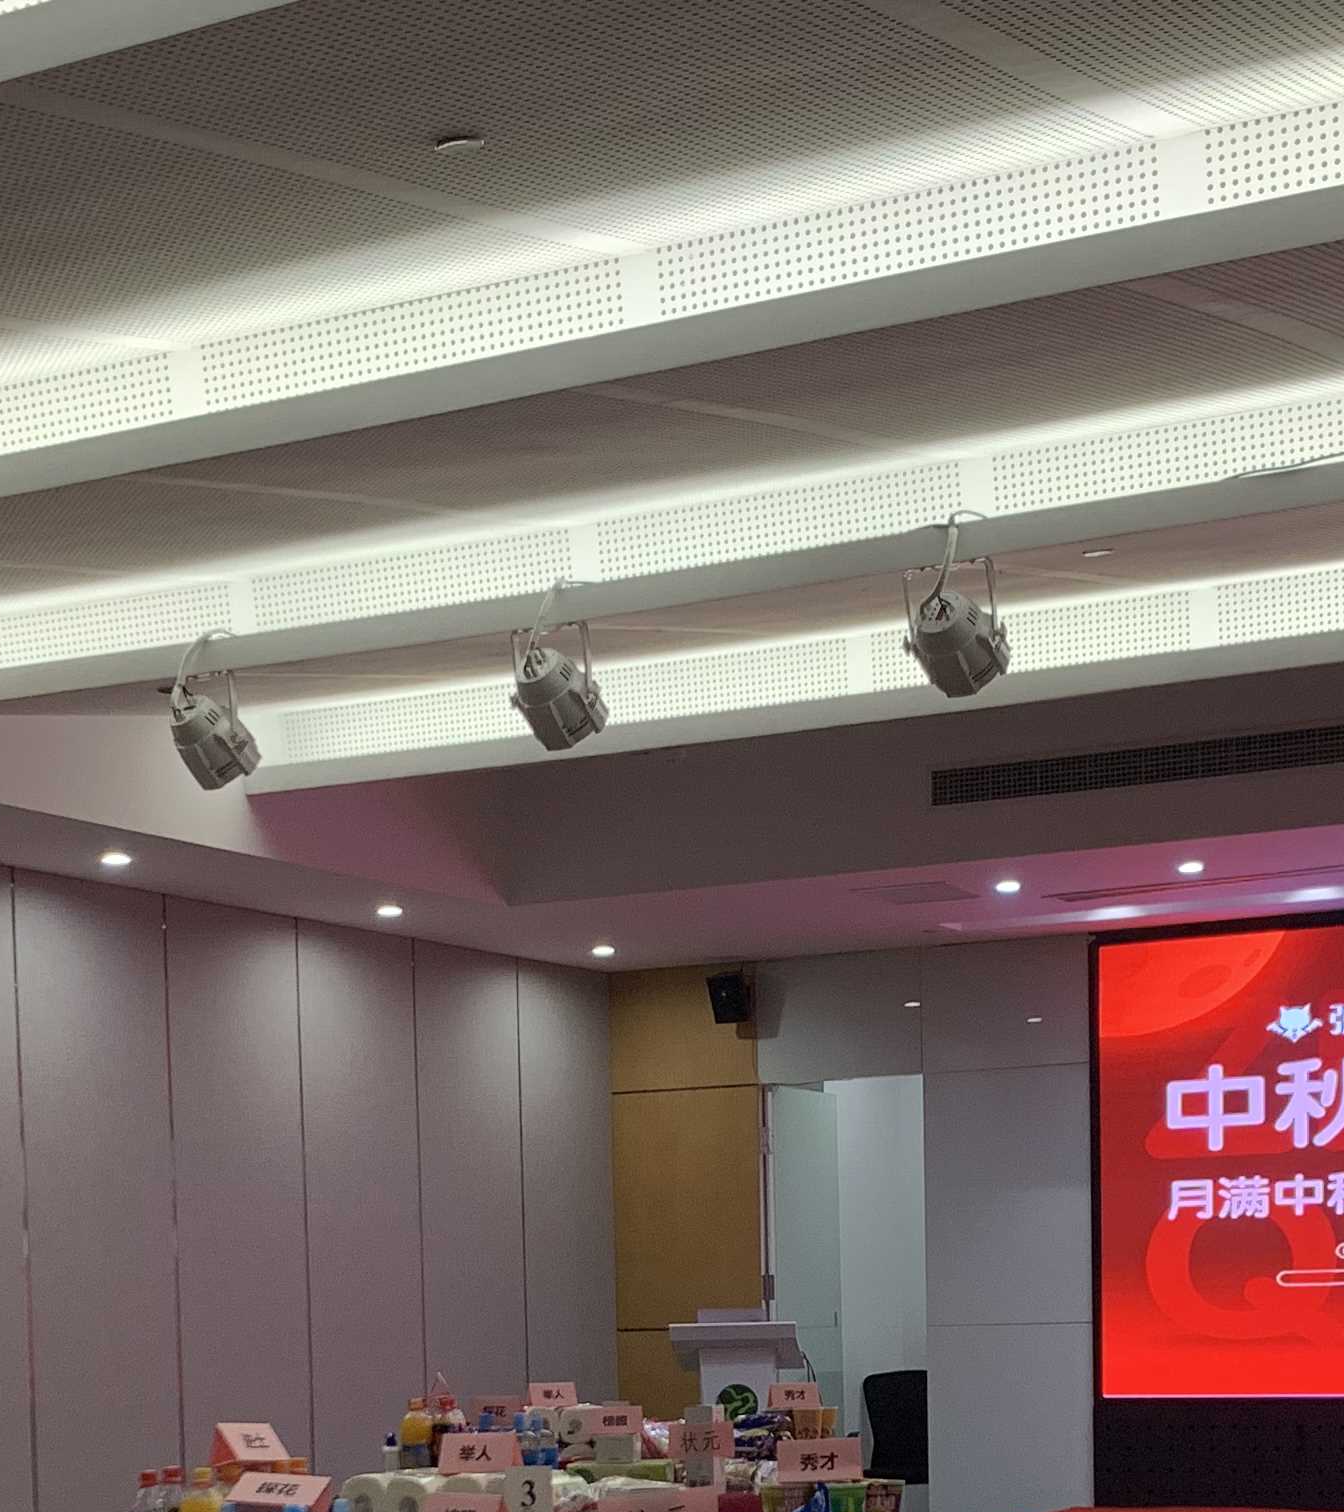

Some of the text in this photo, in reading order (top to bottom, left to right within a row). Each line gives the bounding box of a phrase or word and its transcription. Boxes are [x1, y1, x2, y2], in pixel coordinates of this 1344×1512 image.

[681, 1430, 720, 1453] 状元
[459, 1445, 492, 1461] 举人
[800, 1452, 839, 1471] 秀才
[520, 1480, 537, 1507] 3
